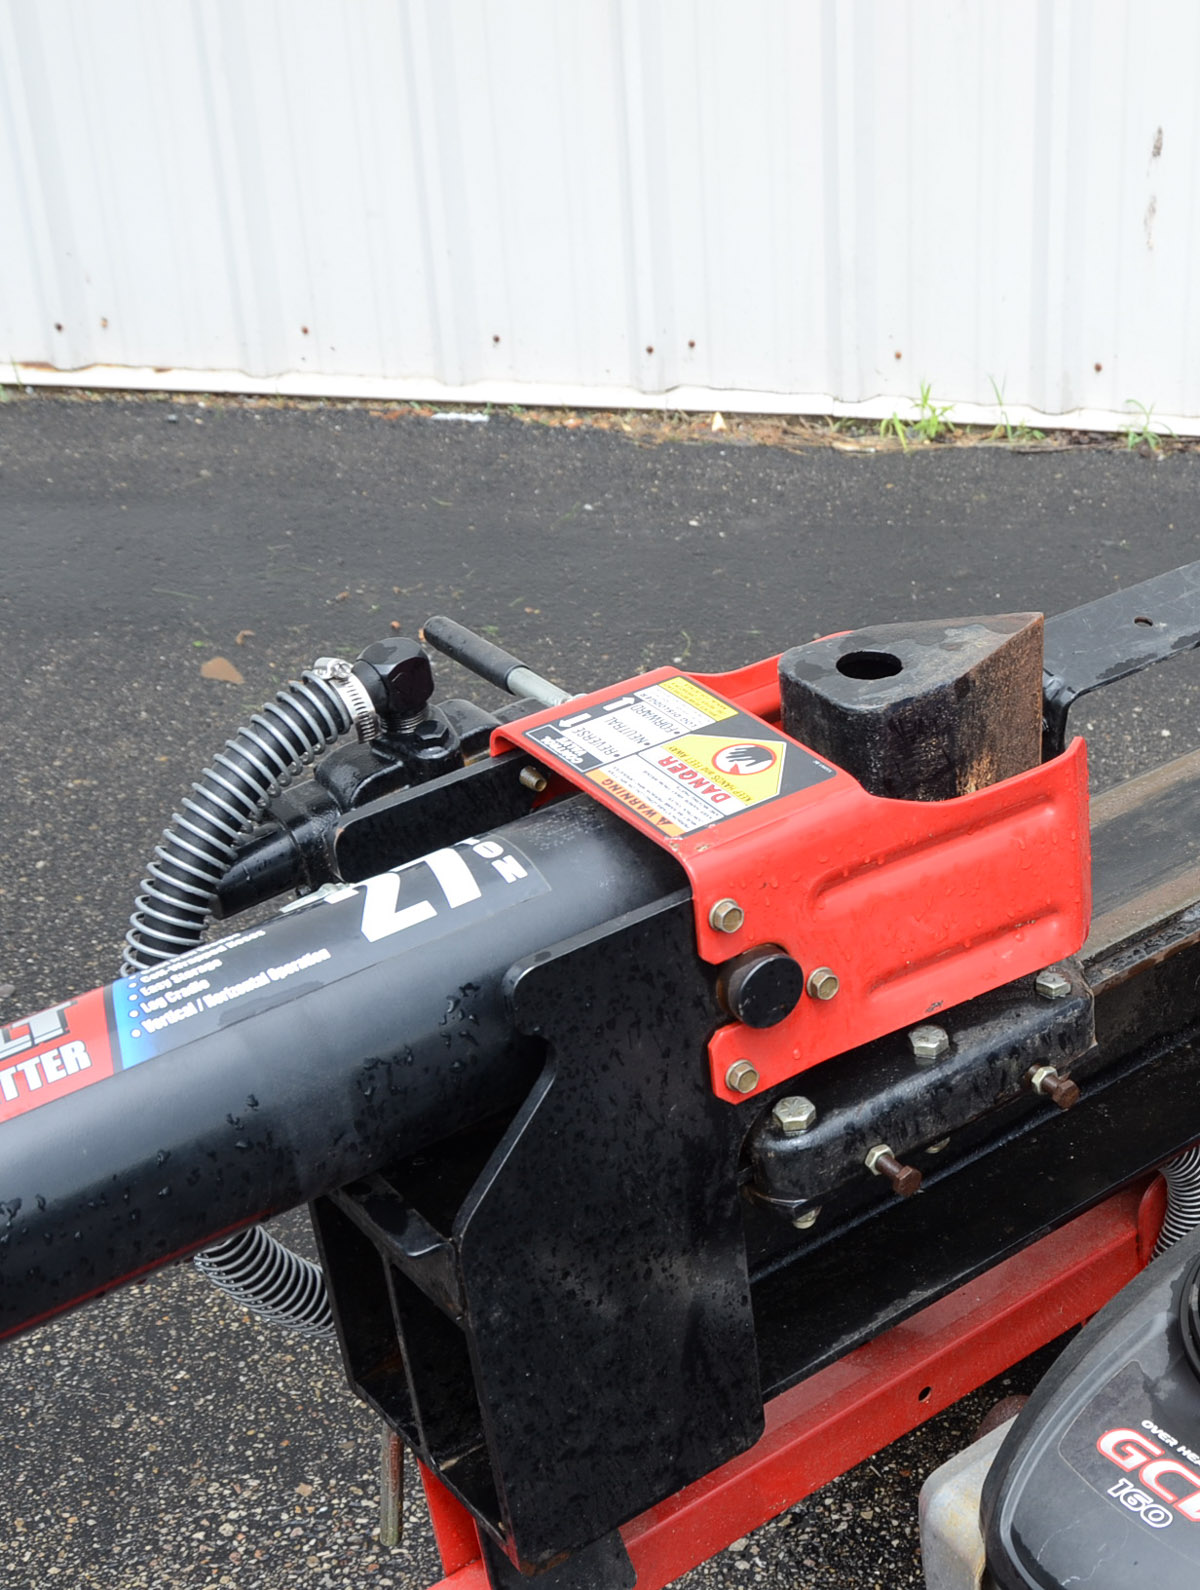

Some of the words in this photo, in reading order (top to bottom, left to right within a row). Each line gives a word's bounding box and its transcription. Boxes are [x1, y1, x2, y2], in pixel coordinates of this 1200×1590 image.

[605, 716, 647, 745] NEUTRAL
[630, 703, 675, 735] FORWARD
[571, 727, 615, 757] REVERSE
[601, 778, 657, 817] WARNING
[658, 755, 732, 803] DANGER
[139, 978, 173, 997] Easy
[170, 958, 223, 985] Storage
[140, 1001, 198, 1034] Vertical
[202, 971, 271, 1009] Horizontal
[266, 948, 332, 981] Operation
[139, 996, 168, 1014] Log
[164, 979, 210, 1003] Cradle
[1141, 1419, 1178, 1448] OVER
[1107, 1478, 1174, 1528] 160
